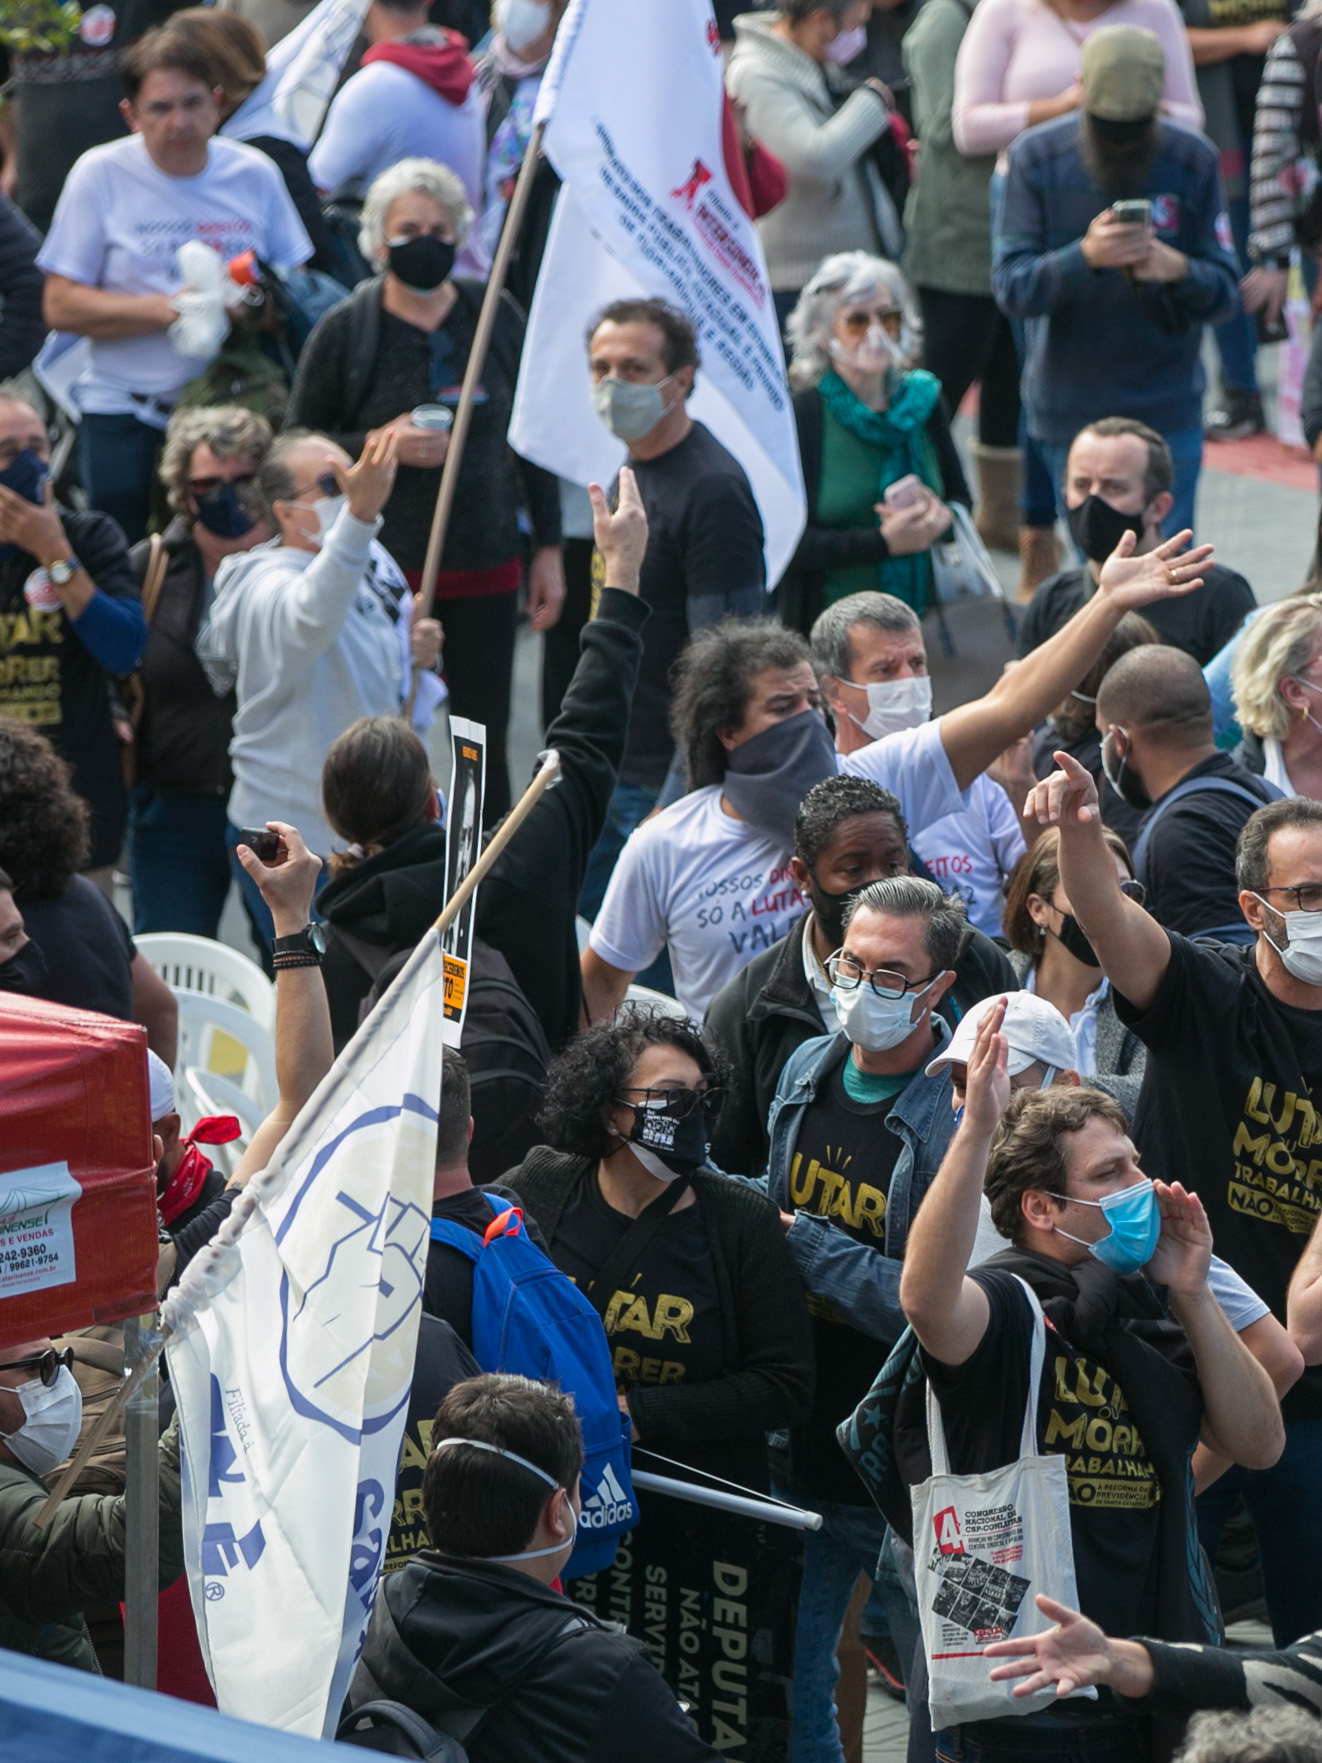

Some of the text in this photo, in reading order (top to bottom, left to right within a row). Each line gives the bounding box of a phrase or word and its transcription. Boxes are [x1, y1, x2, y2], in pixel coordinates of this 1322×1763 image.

[0, 604, 64, 645] TAR
[924, 855, 973, 878] EITOS
[698, 873, 763, 900] OSSOS
[732, 901, 747, 922] A
[752, 887, 806, 917] LUTA
[789, 1151, 888, 1239] UTAR
[1231, 1186, 1273, 1217] NÃO
[9, 1228, 55, 1246] E VENDAS
[0, 1242, 47, 1264] 242-9360
[604, 1289, 695, 1344] TAR
[612, 1346, 686, 1384] RER
[224, 1387, 252, 1443] Filiada
[1044, 1408, 1146, 1458] MORR
[1096, 1491, 1147, 1501] PREVIDÊNCIA
[1104, 1483, 1136, 1493] REFORMA
[580, 1502, 633, 1529] adidas
[965, 1504, 1014, 1519] CONGRESSO
[965, 1514, 1006, 1527] NACIONAL
[965, 1517, 1023, 1534] CSP-CONLUTAS
[644, 1563, 668, 1676] SERVID
[679, 1587, 707, 1655] NÃO
[711, 1560, 748, 1763] DEPUTA
